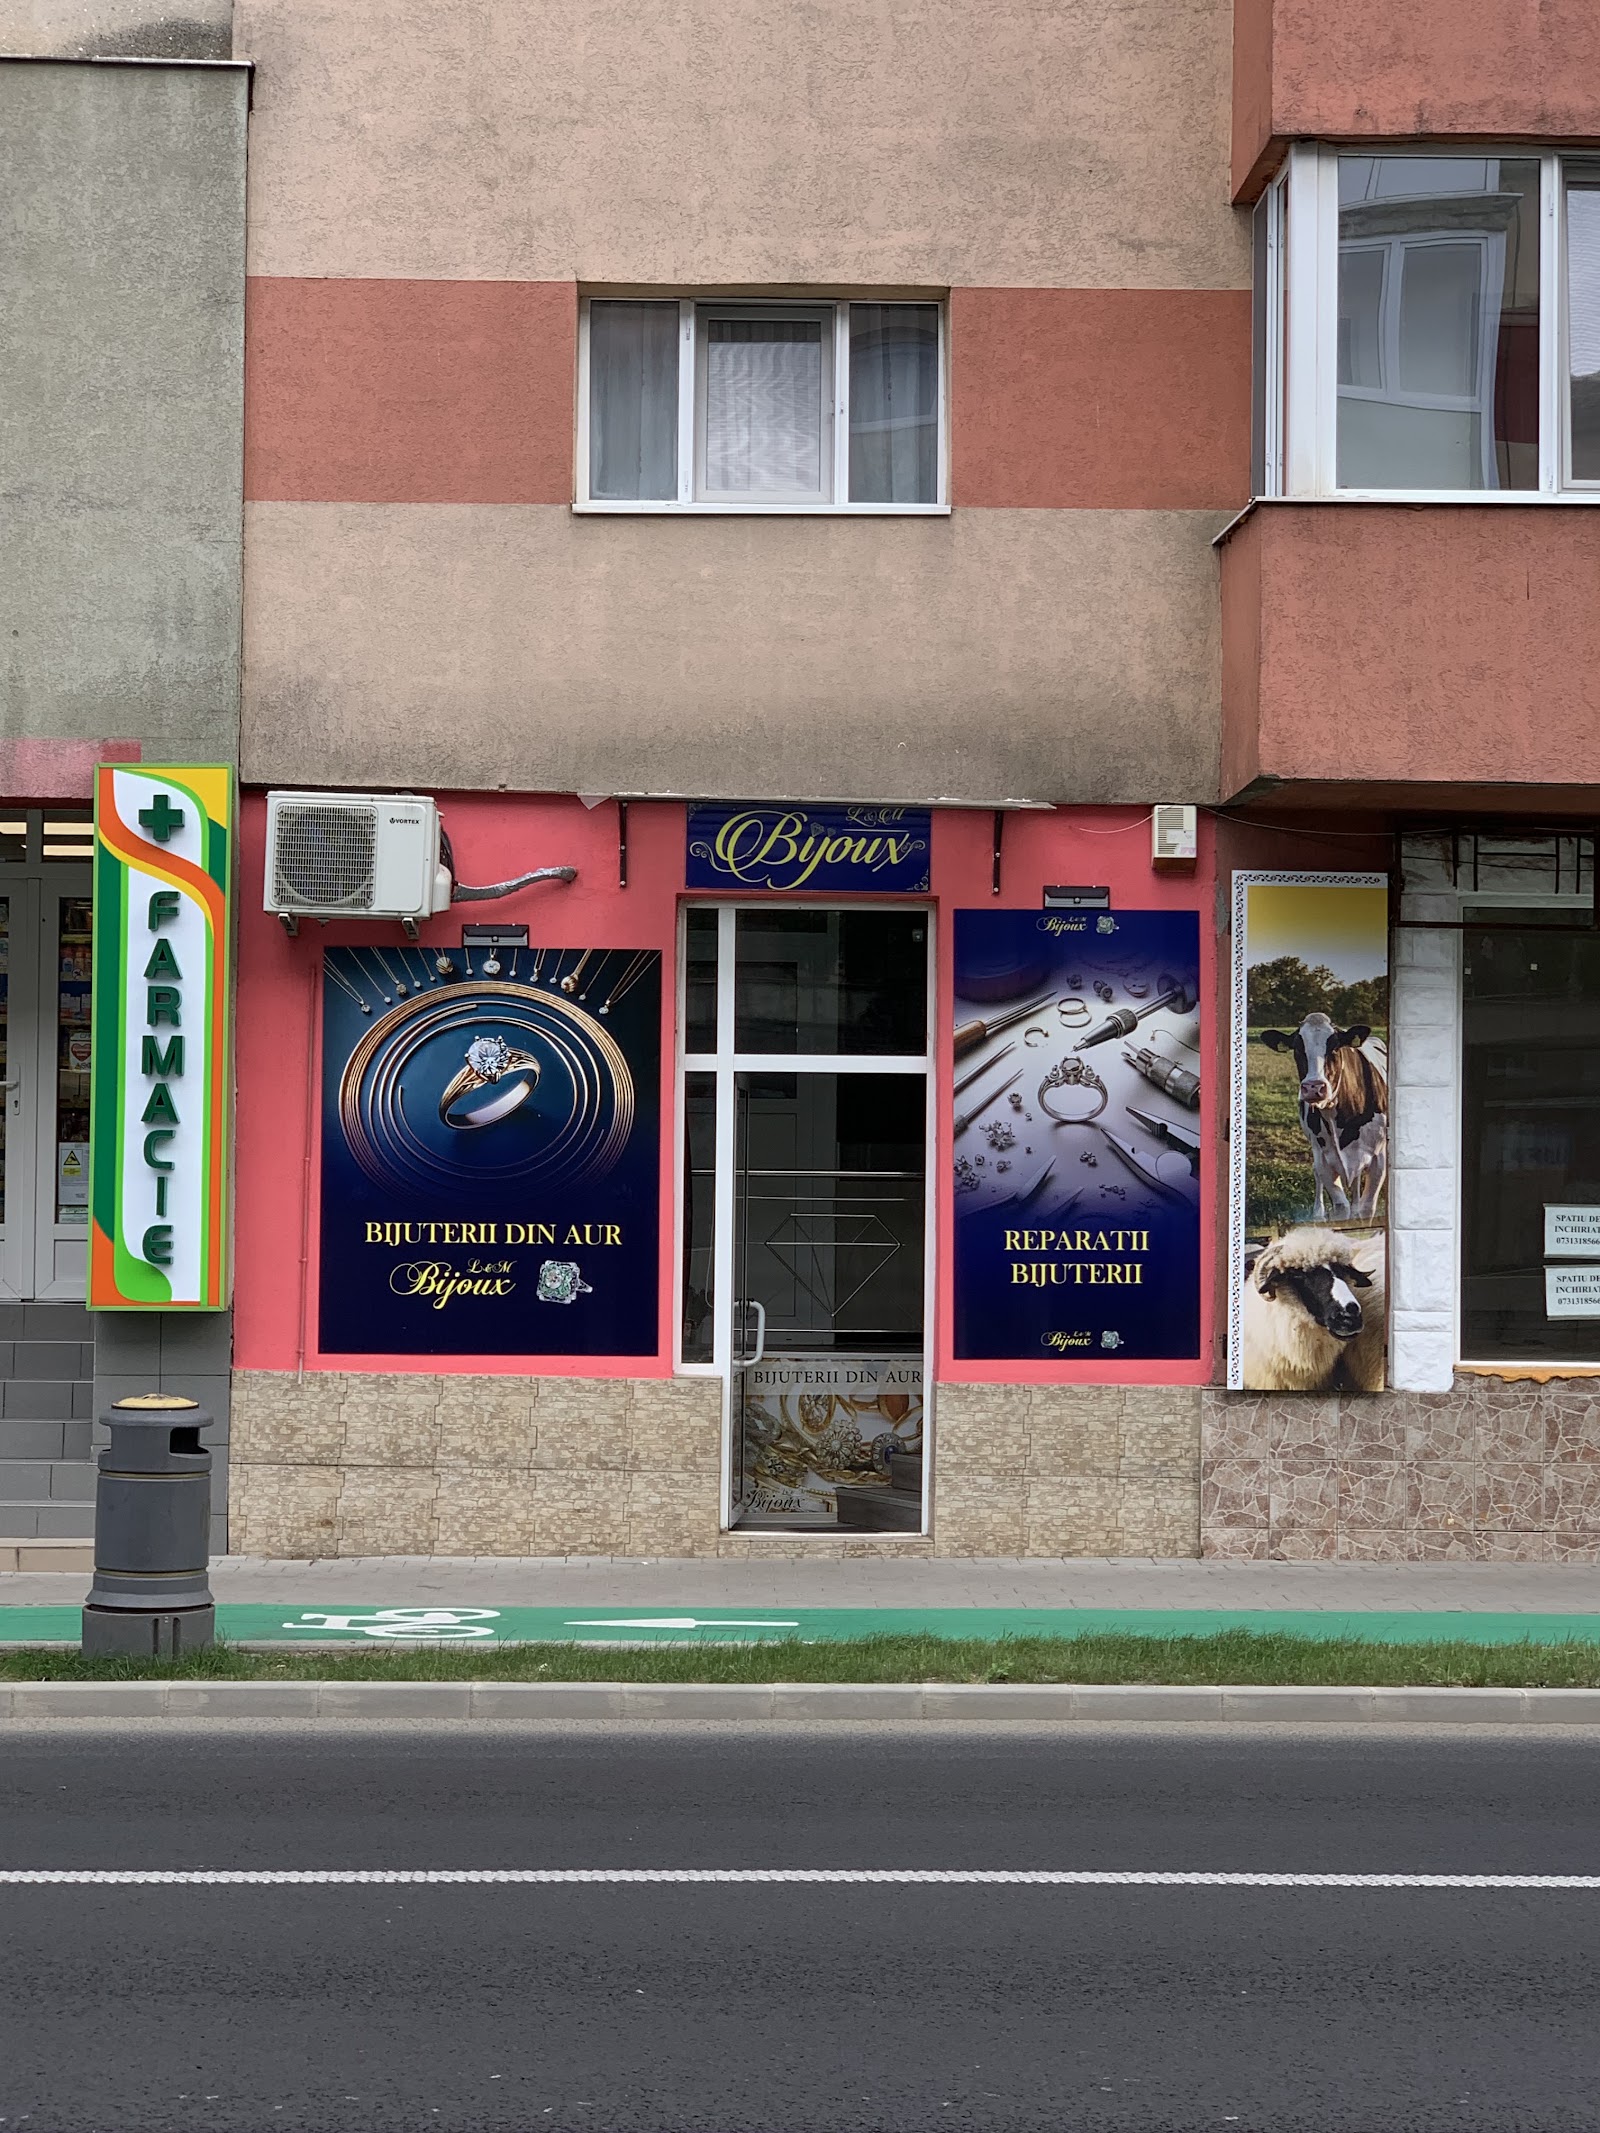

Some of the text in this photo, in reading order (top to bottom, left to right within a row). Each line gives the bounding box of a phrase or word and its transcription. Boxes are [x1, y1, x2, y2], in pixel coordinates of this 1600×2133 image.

[714, 809, 910, 891] Bijoux
[1036, 916, 1088, 937] Bijoux
[140, 889, 186, 1265] FARMACIE
[1555, 1214, 1587, 1222] SPATIU
[364, 1221, 623, 1247] BIJUTERII DIN AUR
[1003, 1229, 1150, 1251] REPARATII
[389, 1260, 517, 1310] Bijoux
[1010, 1262, 1144, 1288] BIJUTERII
[1556, 1275, 1588, 1283] SPATIU
[1040, 1331, 1093, 1352] Bijoux
[753, 1370, 922, 1386] BIJUTERII DIN AUR
